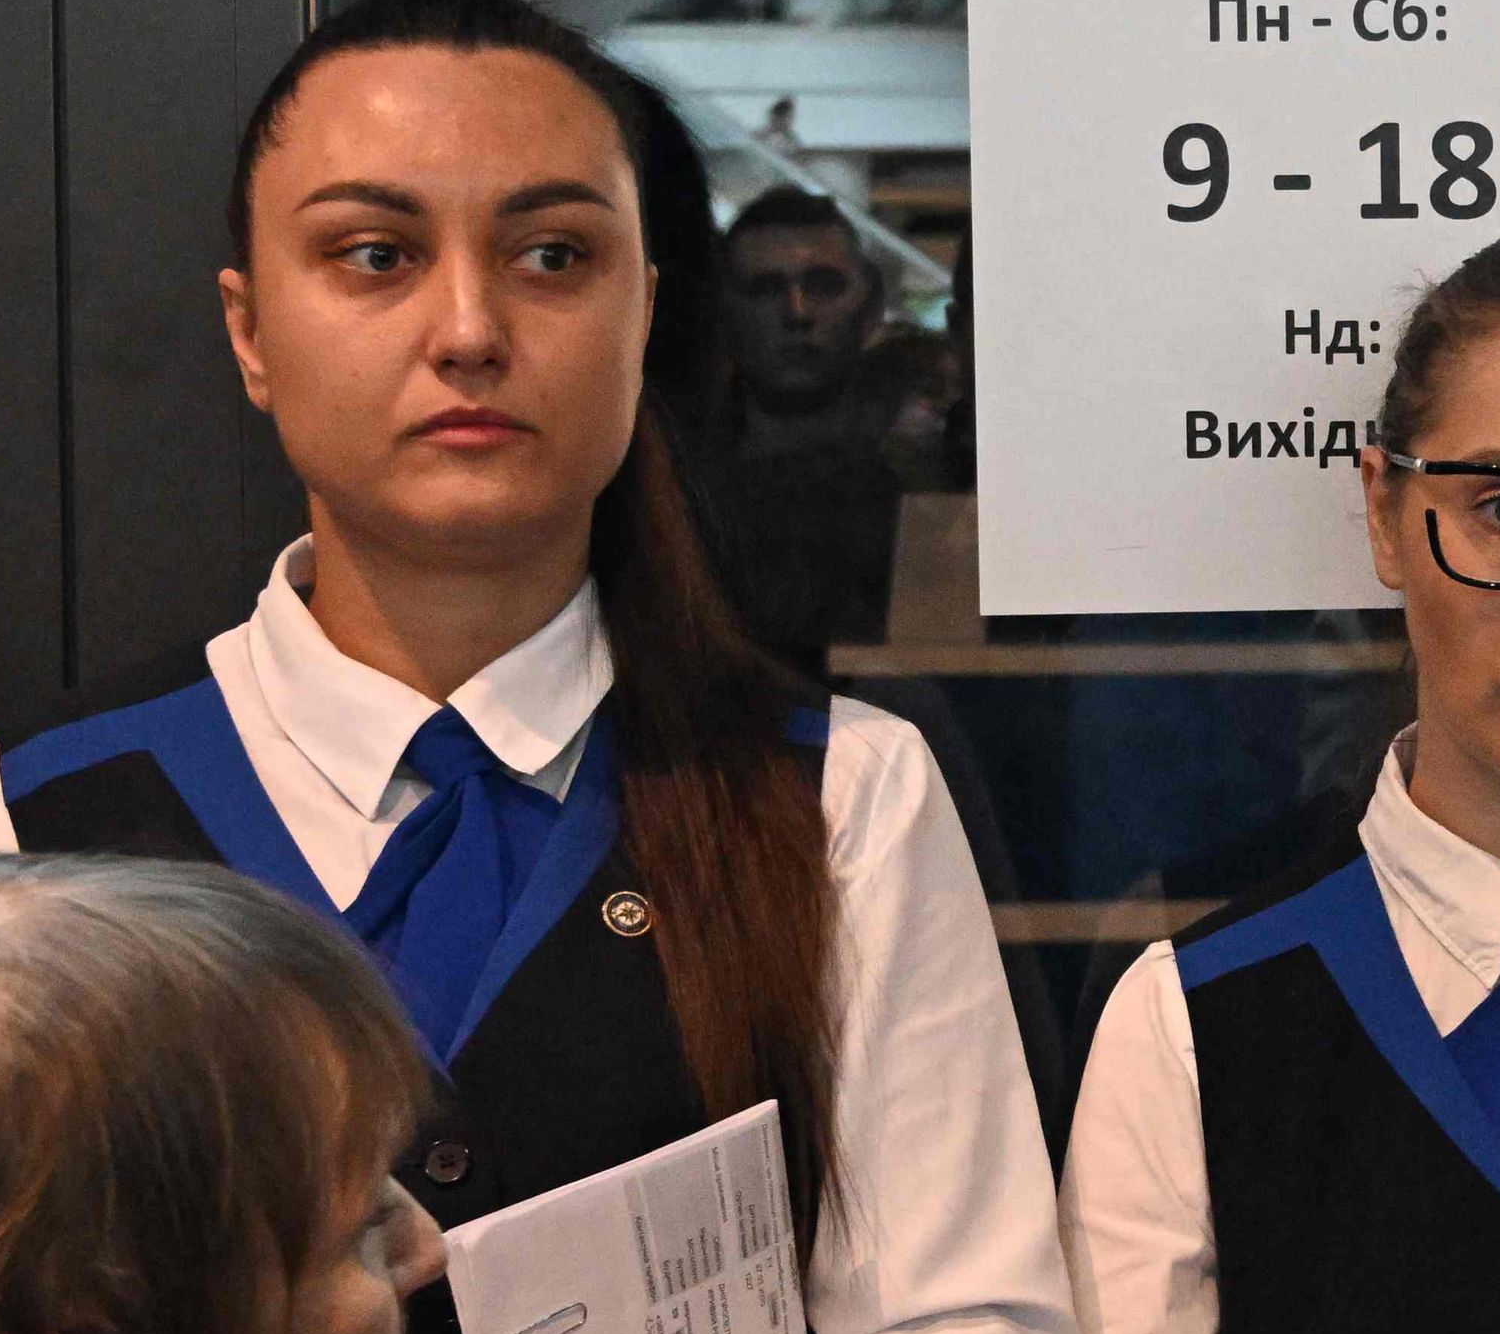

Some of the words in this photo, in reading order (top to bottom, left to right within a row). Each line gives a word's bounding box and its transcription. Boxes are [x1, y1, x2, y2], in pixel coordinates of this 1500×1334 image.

[1162, 122, 1231, 223] 9
[1358, 121, 1498, 220] 18
[1284, 309, 1382, 365] Нд:
[1186, 407, 1379, 469] Вихід
